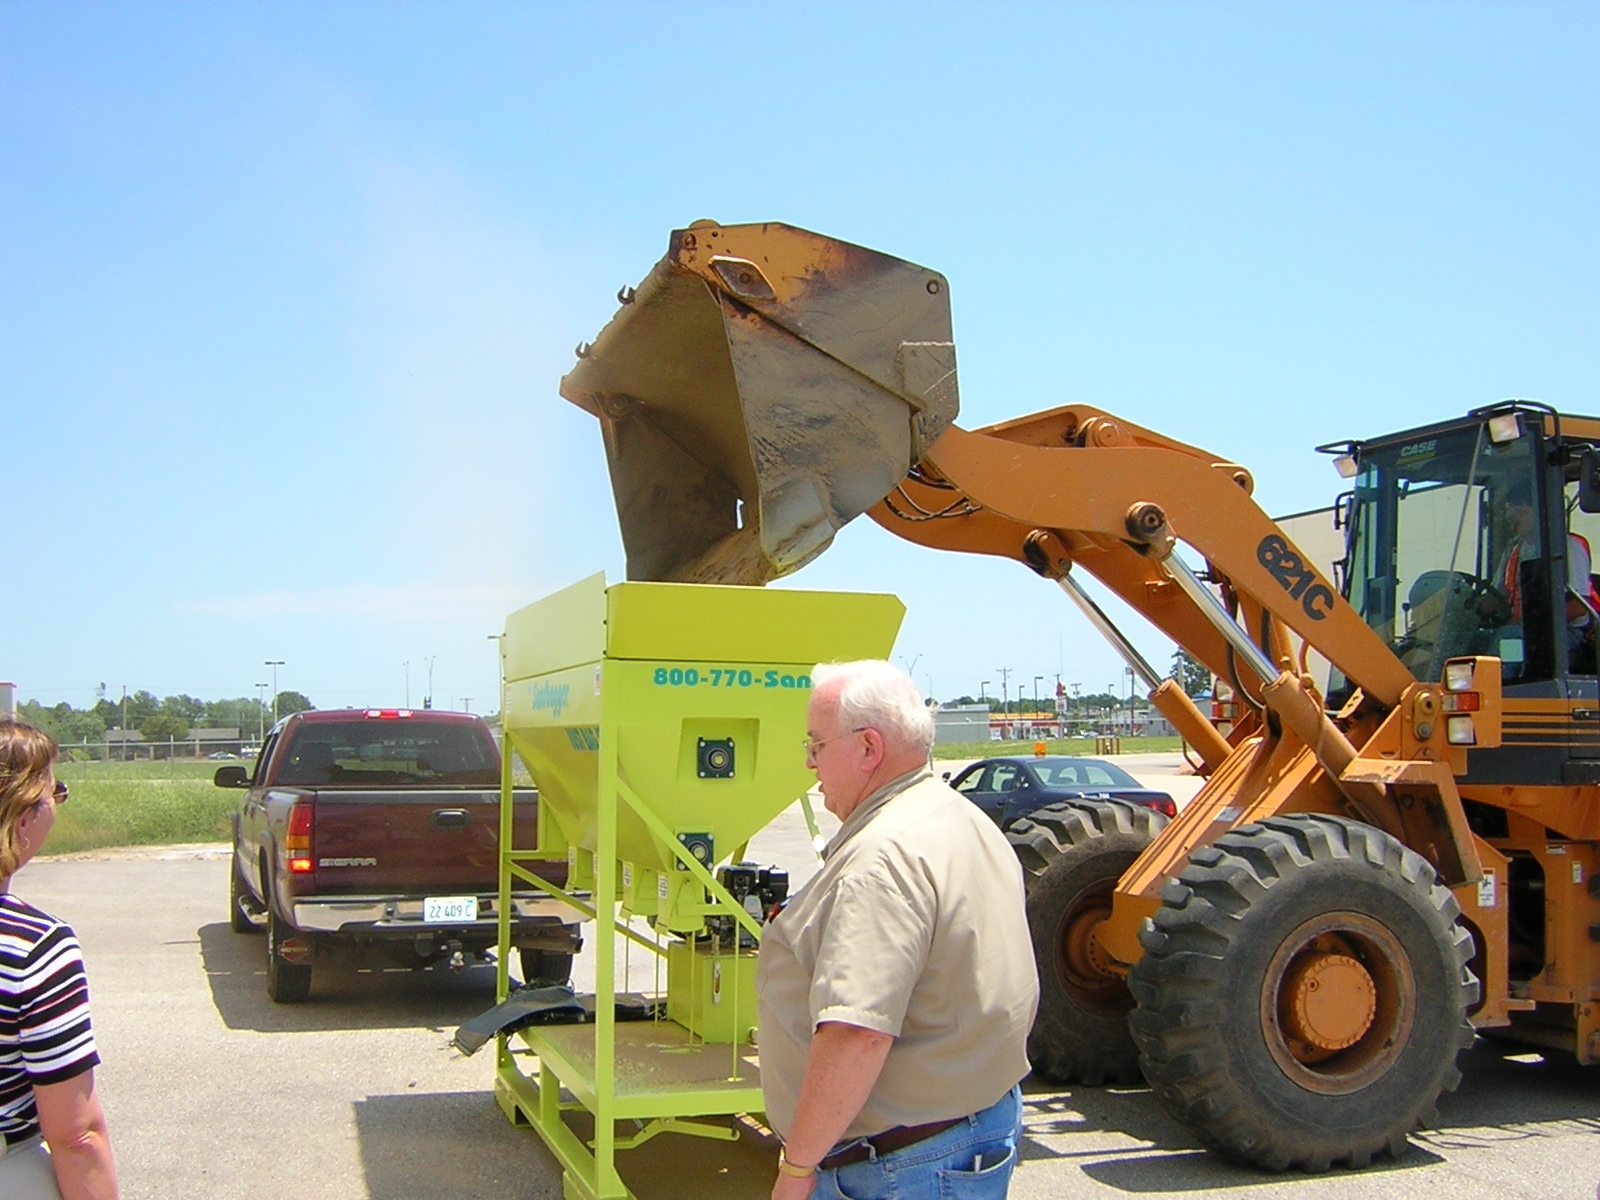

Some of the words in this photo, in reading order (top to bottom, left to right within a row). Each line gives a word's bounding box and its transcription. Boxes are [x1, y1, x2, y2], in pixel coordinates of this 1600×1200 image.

[1400, 439, 1437, 457] CASE
[1256, 533, 1334, 620] 621C
[319, 857, 377, 867] SIERRA
